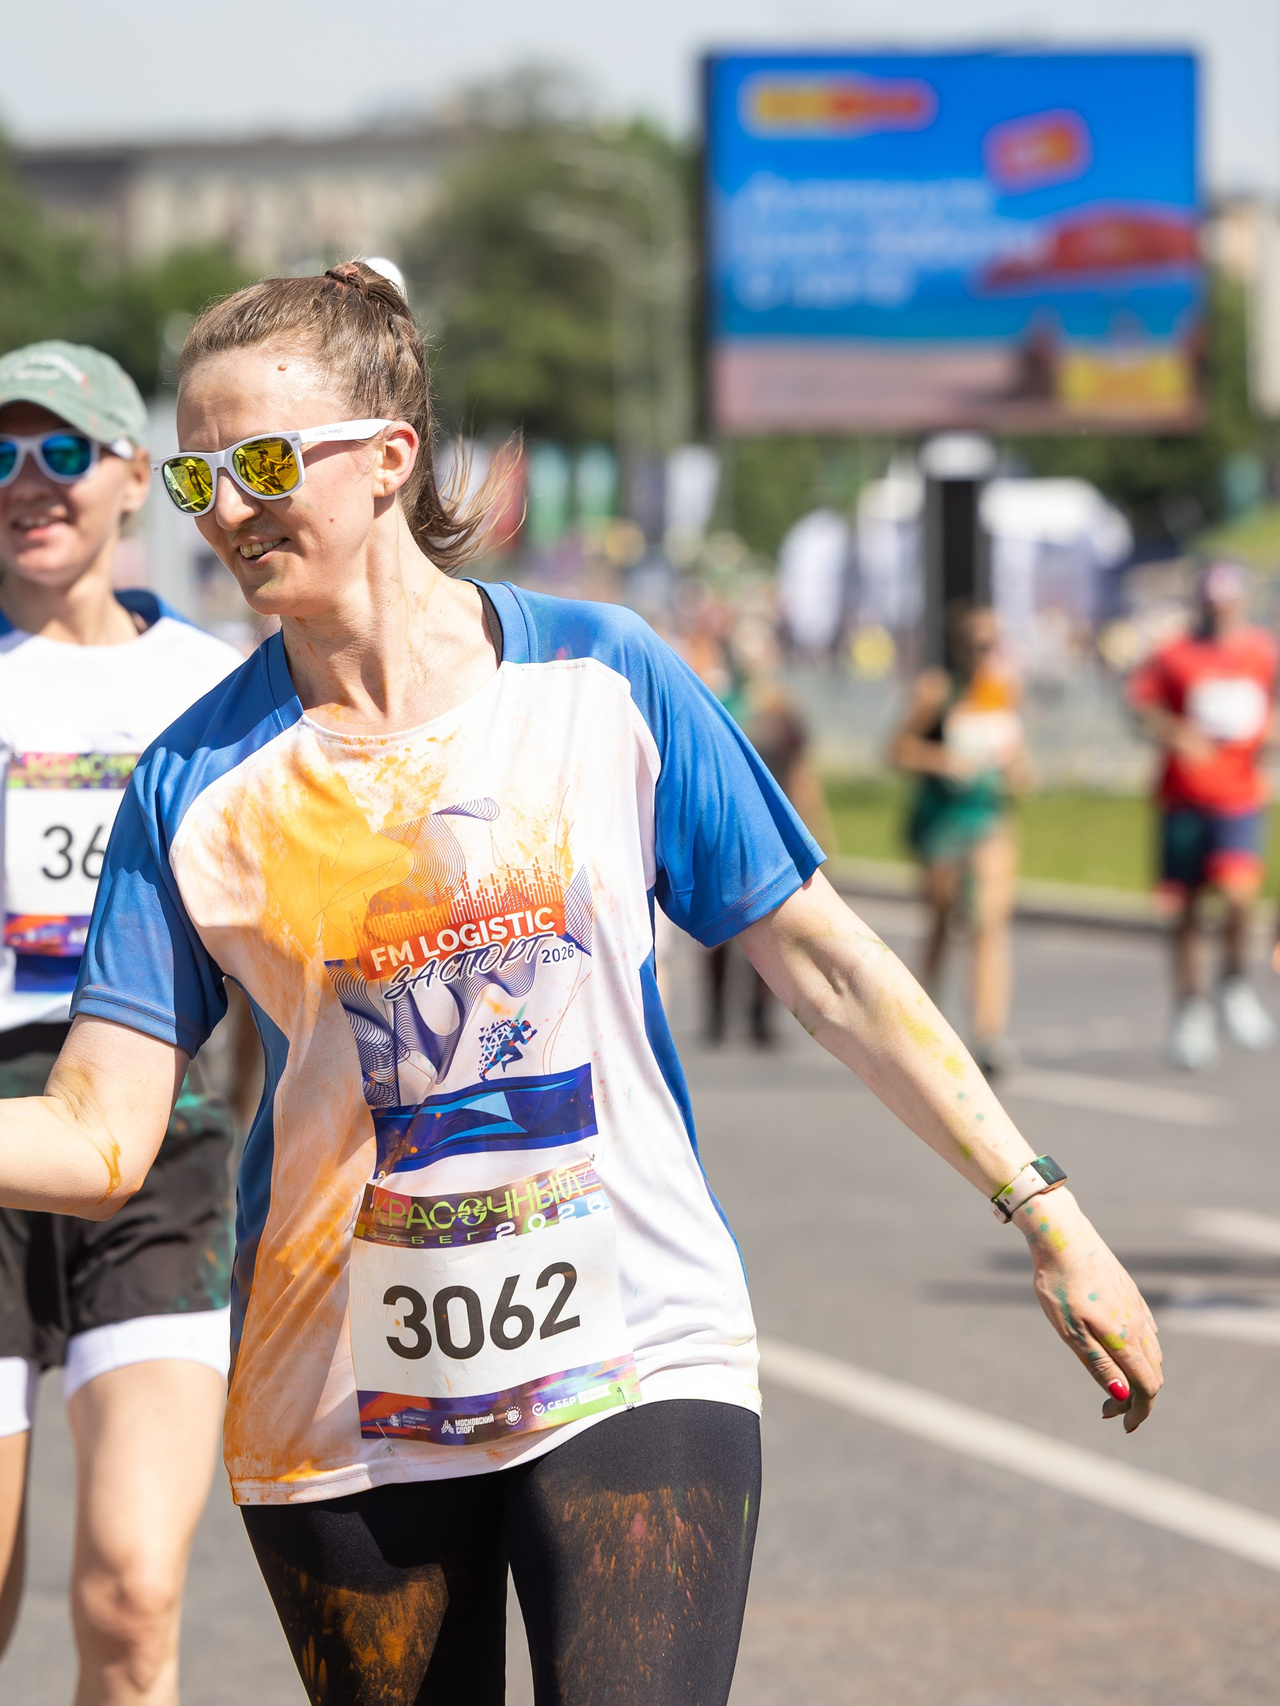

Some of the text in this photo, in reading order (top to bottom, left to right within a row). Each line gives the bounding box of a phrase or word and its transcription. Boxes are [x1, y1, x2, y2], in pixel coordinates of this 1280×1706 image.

[370, 907, 556, 972] FM LOGISTIC
[541, 945, 576, 964] 2026
[373, 1168, 584, 1230] КРАСОЧНЫЙ
[496, 1194, 606, 1240] 2026
[368, 1230, 480, 1245] ЗАБЕГ
[383, 1262, 581, 1360] 3062
[547, 1397, 577, 1411] СБЕР
[455, 1413, 495, 1427] МОСКОВСКИЙ
[456, 1426, 475, 1434] СПОРТ
